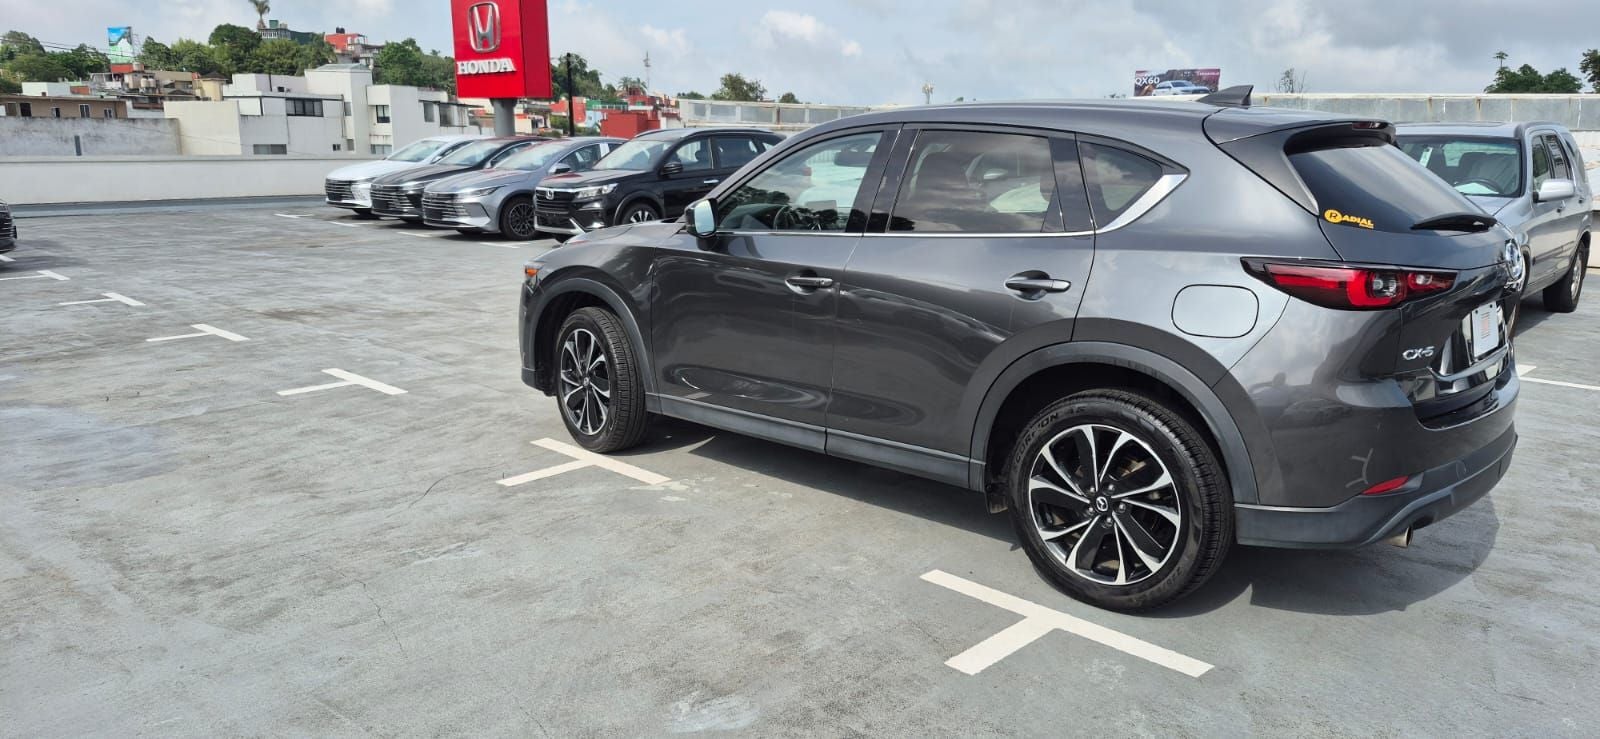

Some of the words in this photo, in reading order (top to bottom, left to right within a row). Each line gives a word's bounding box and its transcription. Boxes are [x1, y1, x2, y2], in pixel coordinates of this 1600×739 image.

[456, 58, 516, 75] HONDA
[1134, 77, 1160, 86] QX60
[1402, 346, 1434, 360] CX-5
